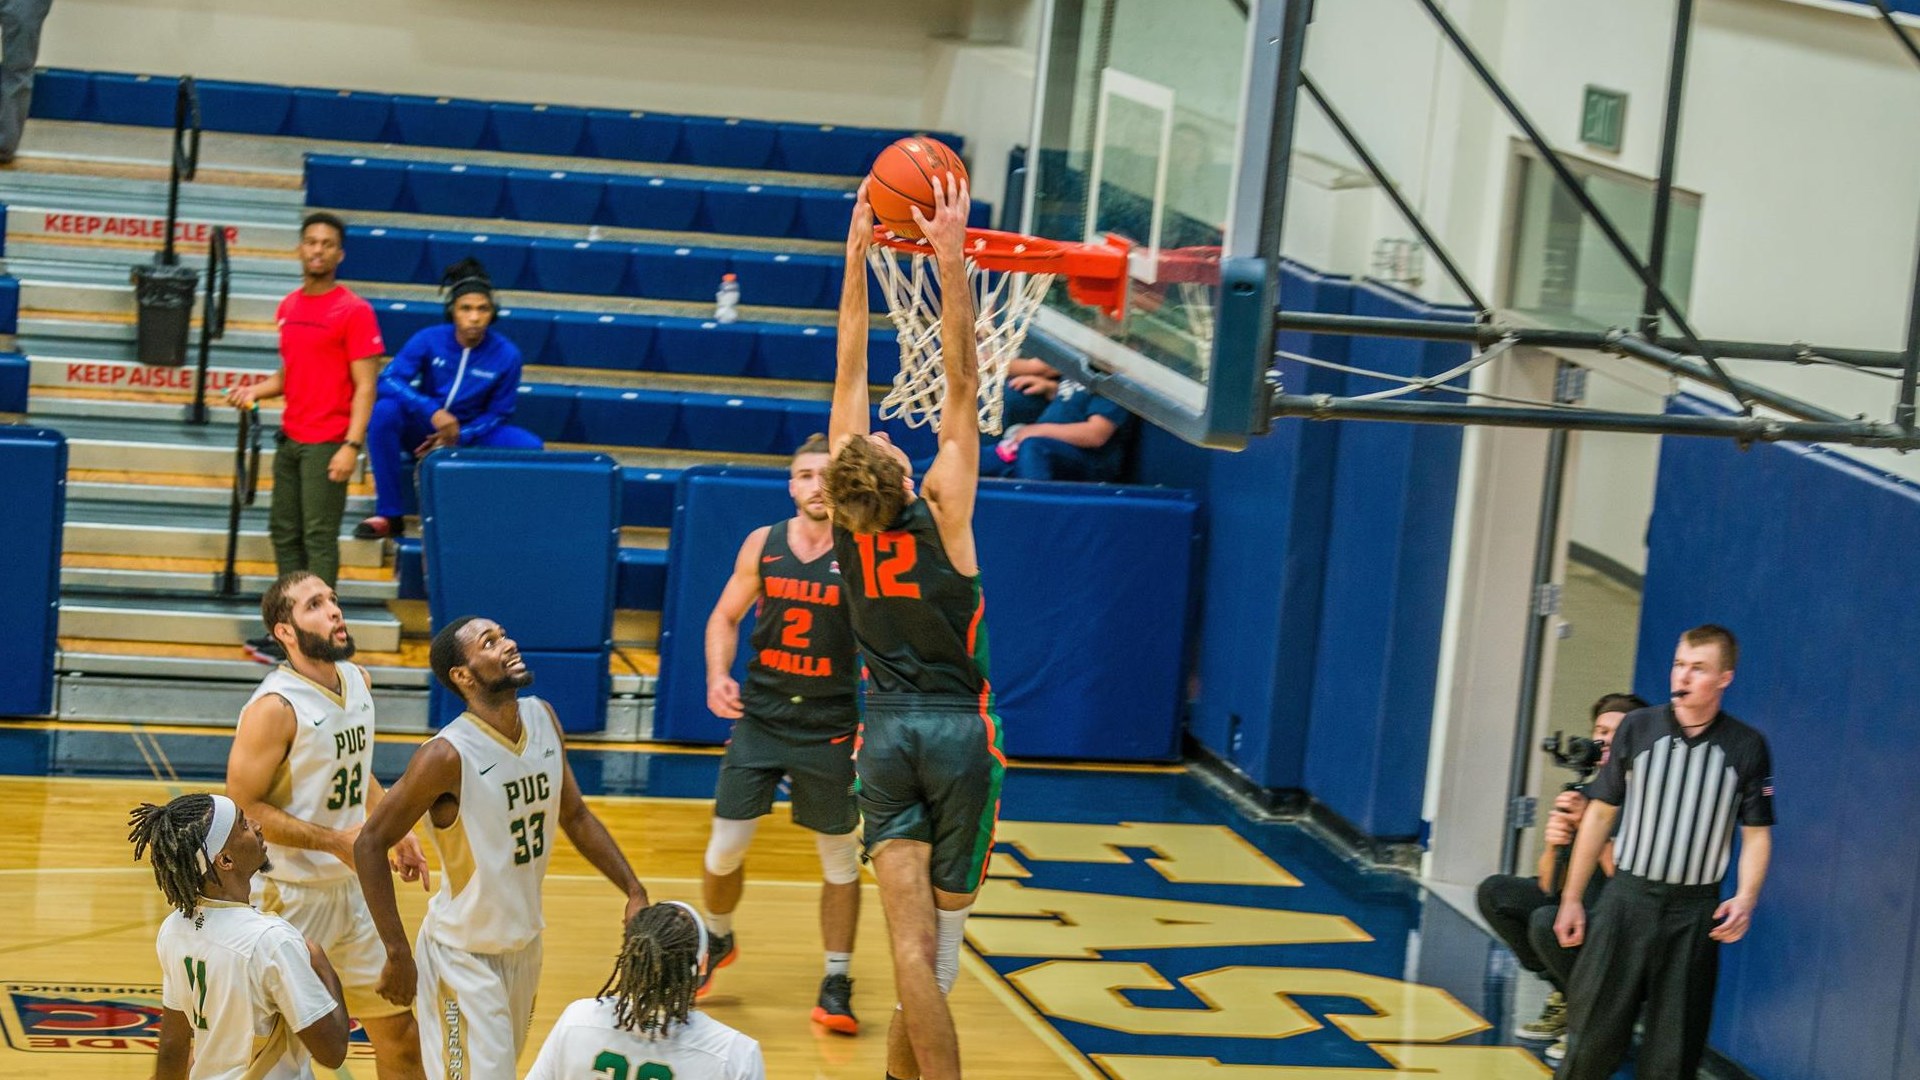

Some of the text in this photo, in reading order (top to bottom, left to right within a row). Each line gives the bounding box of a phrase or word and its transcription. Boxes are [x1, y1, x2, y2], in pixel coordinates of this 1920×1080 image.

[45, 213, 239, 244] KEEP AISLE CLER
[67, 364, 126, 384] KEEP
[128, 367, 192, 389] AISLE
[853, 531, 921, 598] 12
[765, 576, 840, 606] WALLA
[781, 607, 813, 648] 2
[760, 649, 832, 676] WALLA
[333, 725, 366, 759] PUC
[327, 762, 362, 810] 32
[502, 771, 550, 811] PUC
[510, 811, 546, 865] 33
[7, 985, 163, 995] ONFERENCE
[184, 956, 208, 1031] 11
